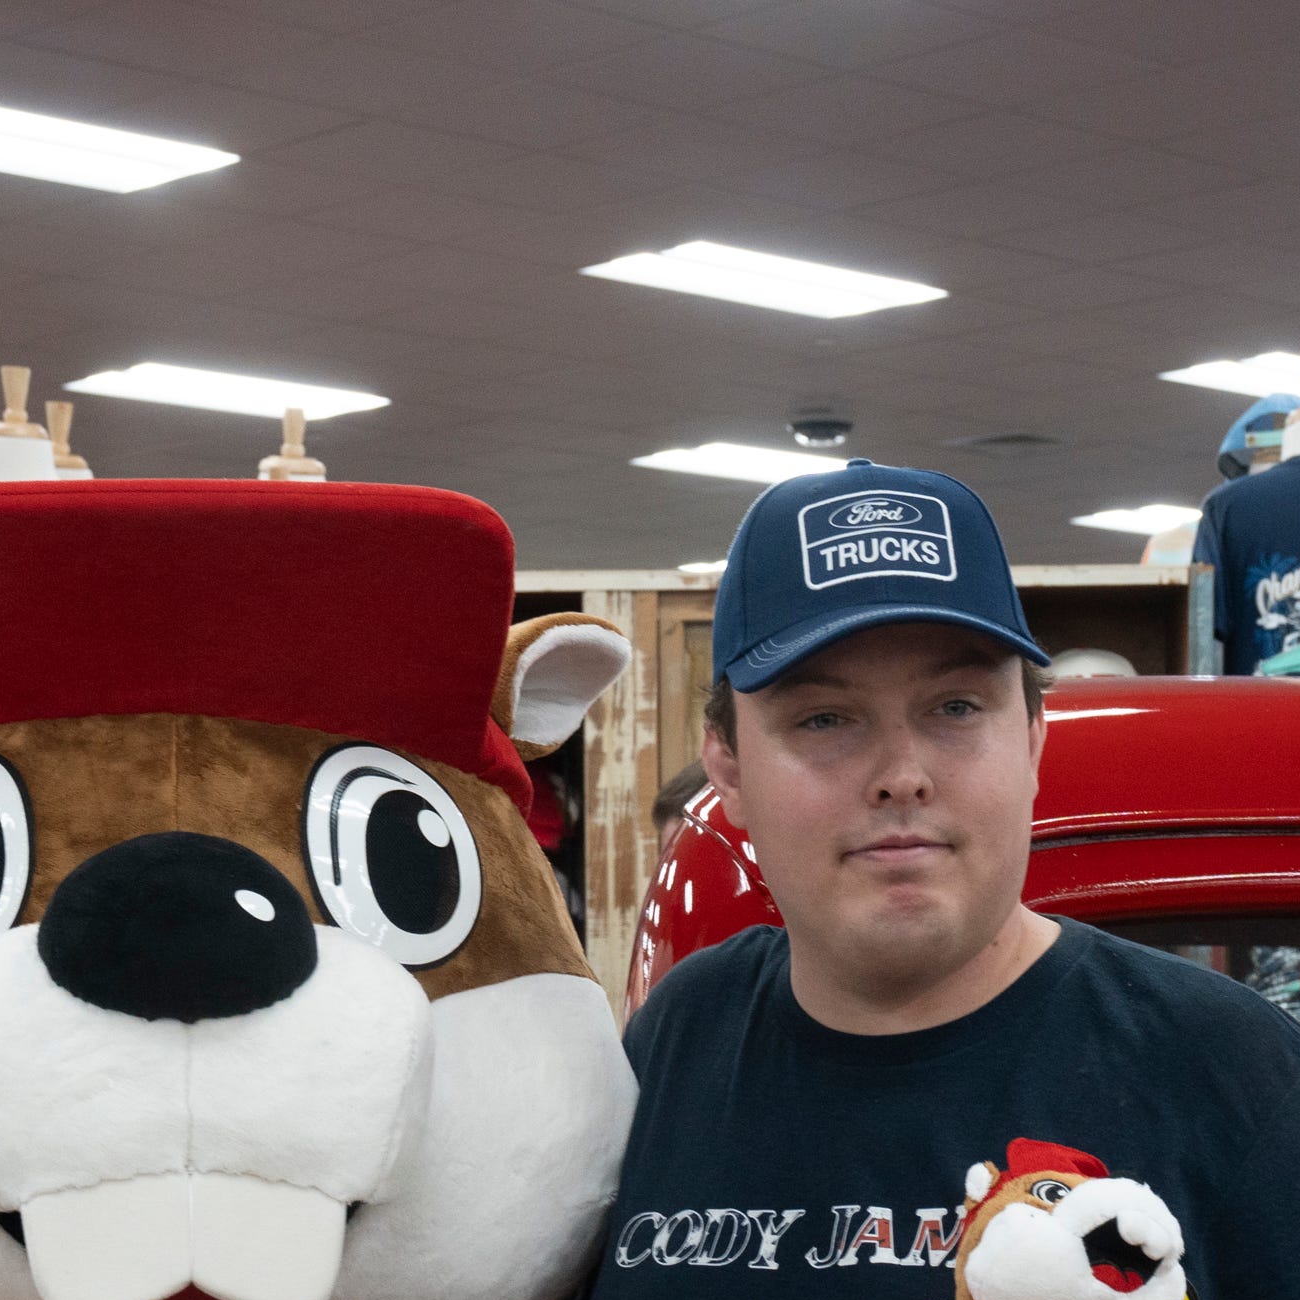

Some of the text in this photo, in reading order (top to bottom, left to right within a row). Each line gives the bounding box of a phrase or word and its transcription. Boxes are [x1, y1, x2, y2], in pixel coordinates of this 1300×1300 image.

[846, 501, 905, 525] Ford
[819, 537, 941, 571] TRUCKS
[614, 1208, 806, 1270] CODY
